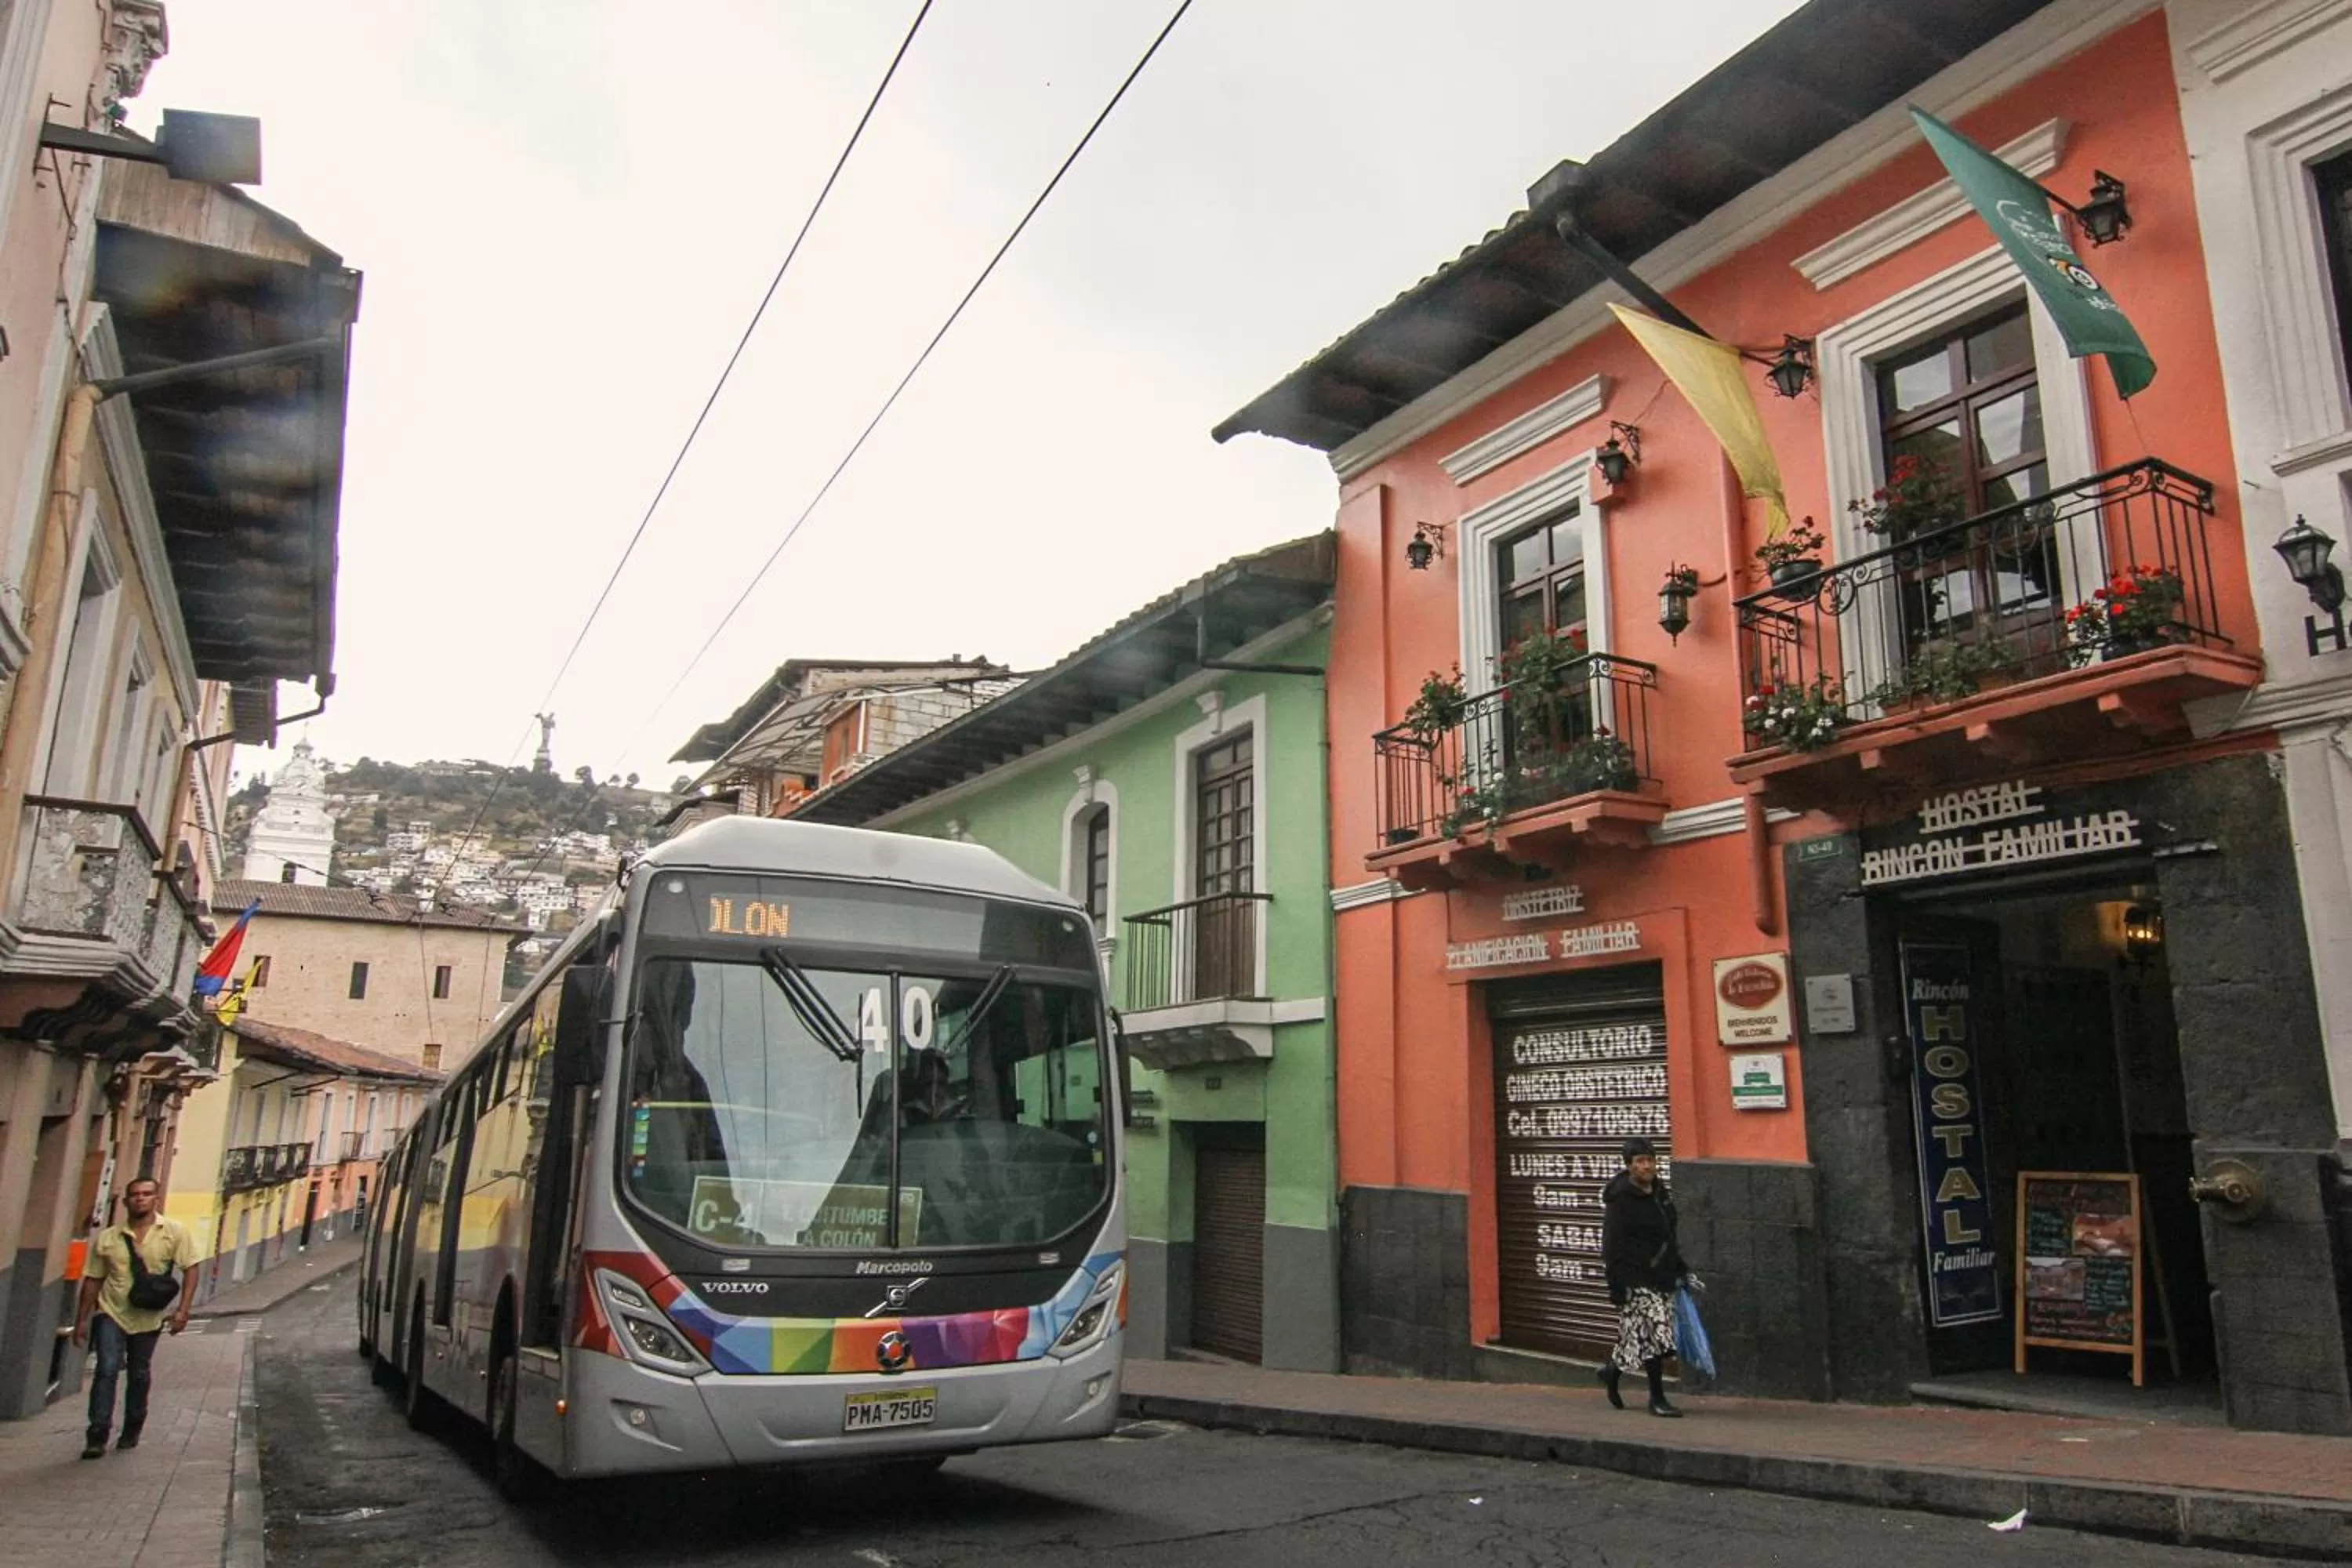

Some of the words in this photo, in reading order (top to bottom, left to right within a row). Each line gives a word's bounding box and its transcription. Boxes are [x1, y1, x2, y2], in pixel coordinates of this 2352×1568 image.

[1918, 779, 2045, 834] HOSTAL
[1861, 837, 1965, 885] RINCON
[1982, 810, 2142, 869] FAMILIAR
[1446, 934, 1550, 969] PLANIFICACION
[1560, 921, 1641, 958] FAMILIAR
[1911, 978, 1969, 1000] Rincón
[1513, 1025, 1652, 1064] CONSULTORIO
[1734, 1027, 1773, 1037] WELCOME
[1506, 1073, 1560, 1102] GINECO
[1564, 1065, 1668, 1100] OBSTETRICO
[1508, 1109, 1542, 1136] Cel.
[1920, 1006, 1981, 1245] HOSTAL
[1510, 1153, 1566, 1177] LUNES
[1571, 1153, 1584, 1178] A
[1537, 1223, 1603, 1252] SABA
[855, 1261, 933, 1275] Marcopolo
[1933, 1248, 1995, 1273] Familiar
[702, 1281, 770, 1294] VOLVO
[848, 1399, 934, 1425] PMA-7505
